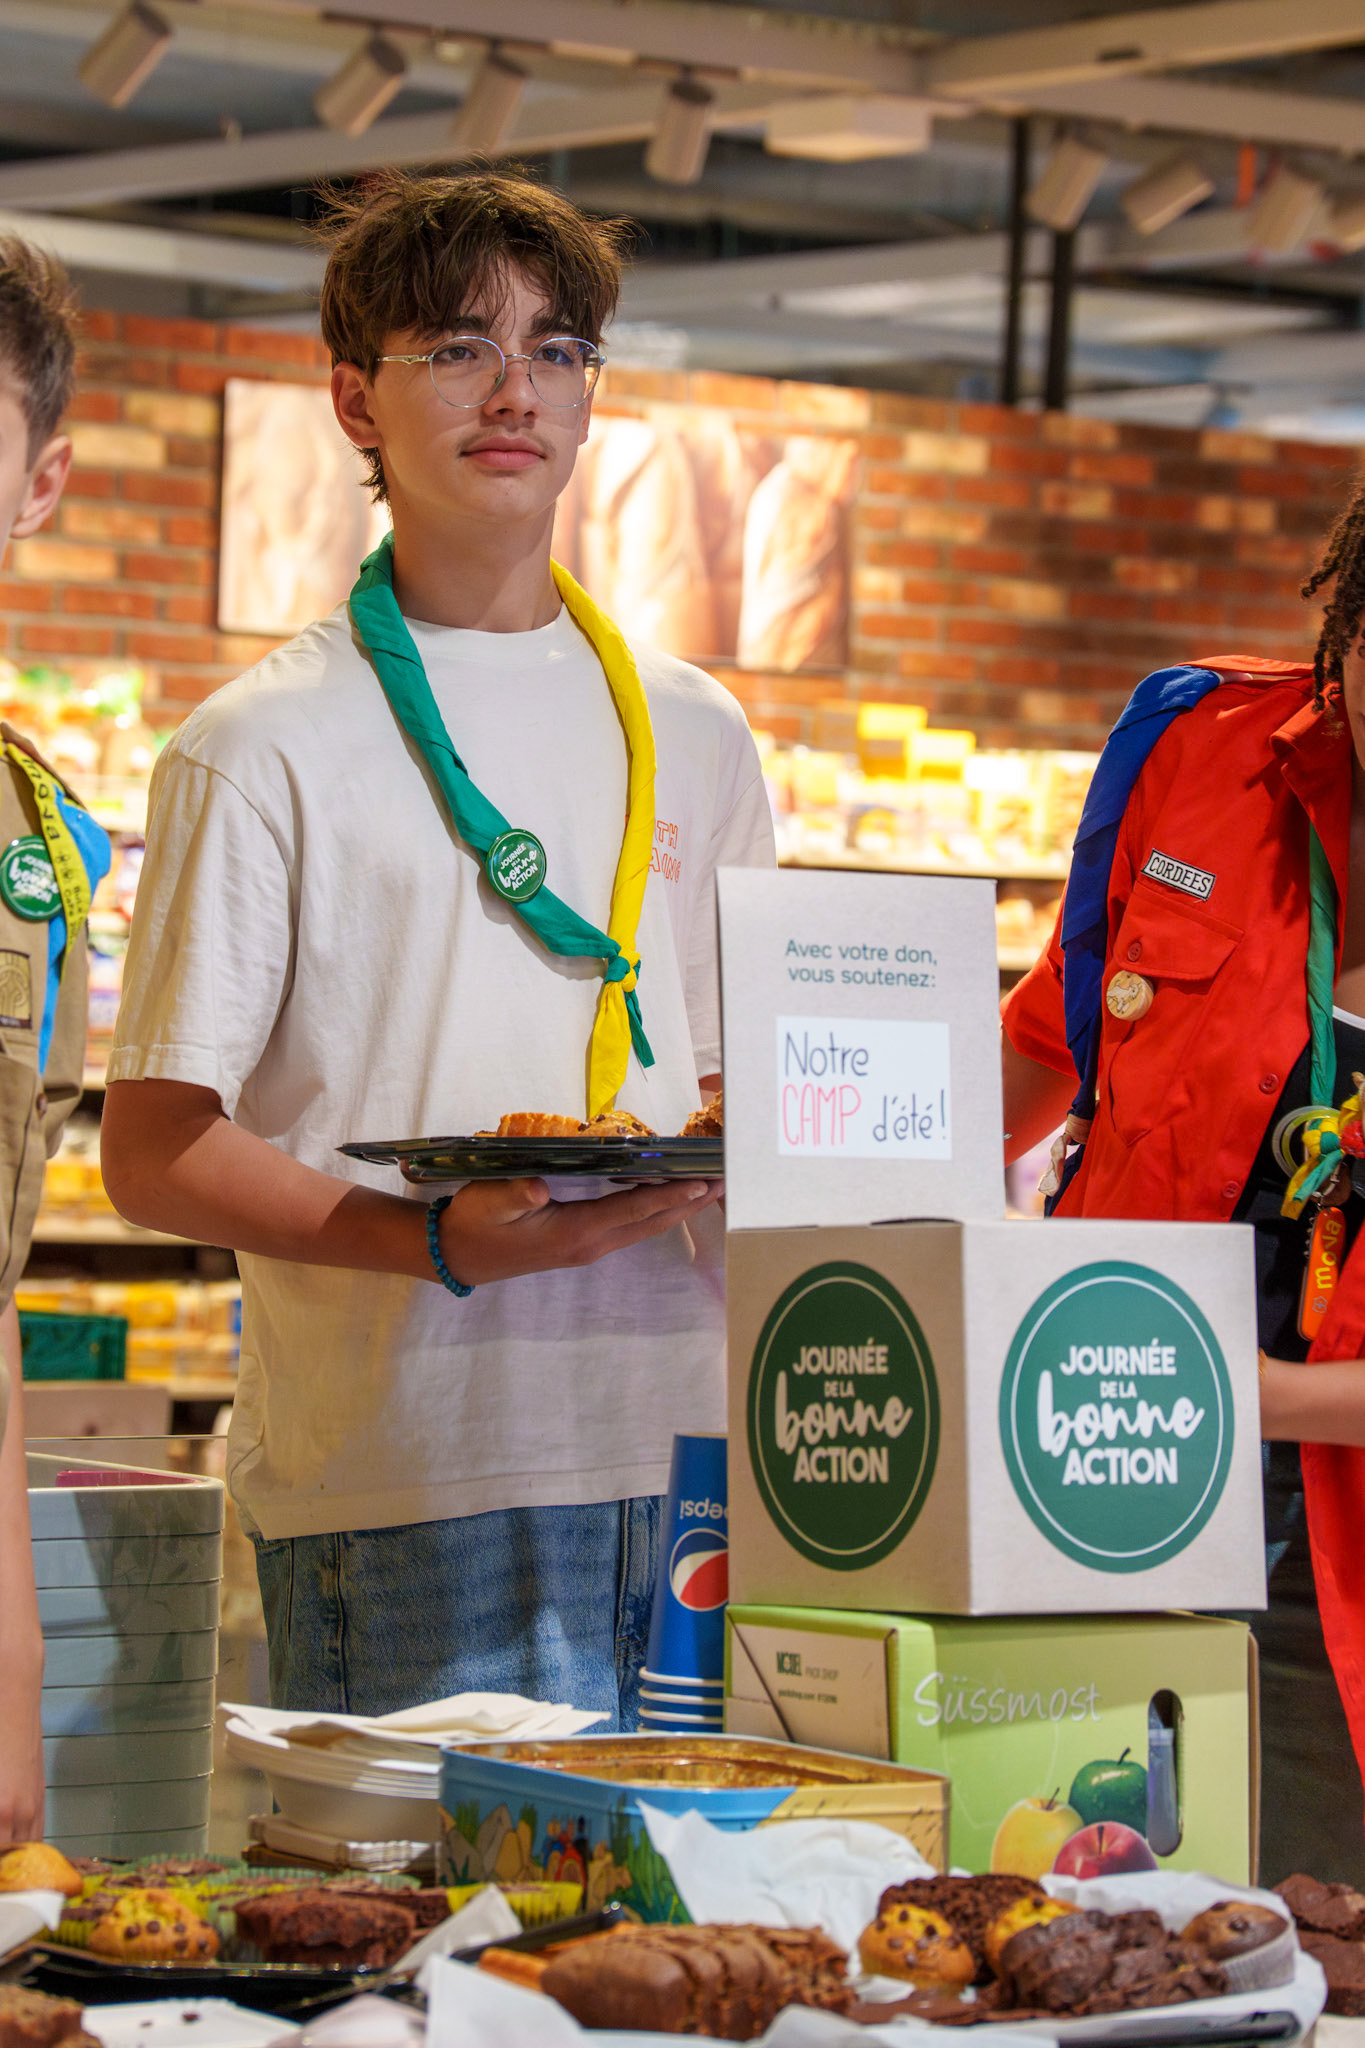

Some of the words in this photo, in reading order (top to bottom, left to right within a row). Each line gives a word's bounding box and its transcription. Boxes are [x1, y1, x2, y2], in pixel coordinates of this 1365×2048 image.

[497, 850, 537, 889] bonne
[500, 843, 527, 870] JOURNÉE
[1149, 856, 1211, 893] CORDEES
[511, 862, 539, 891] ACTION
[785, 939, 833, 959] Avec
[838, 944, 889, 961] votre
[894, 946, 938, 966] don,
[788, 967, 835, 983] vous
[841, 968, 936, 988] soutenez:
[785, 1031, 869, 1077] Notre
[782, 1082, 861, 1147] CAMP
[1315, 1219, 1342, 1289] mova
[792, 1337, 889, 1375] JOURNÉE
[1059, 1337, 1177, 1376] JOURNÉE
[824, 1381, 838, 1398] DE
[840, 1381, 855, 1398] LA
[1100, 1381, 1117, 1398] DE
[1119, 1381, 1137, 1398] LA
[775, 1370, 914, 1456] bonne
[1037, 1369, 1205, 1458] bonne
[793, 1446, 889, 1484] ACTION
[1062, 1447, 1178, 1485] ACTION
[679, 1497, 729, 1520] epsi
[914, 1672, 1102, 1728] Süssmost
